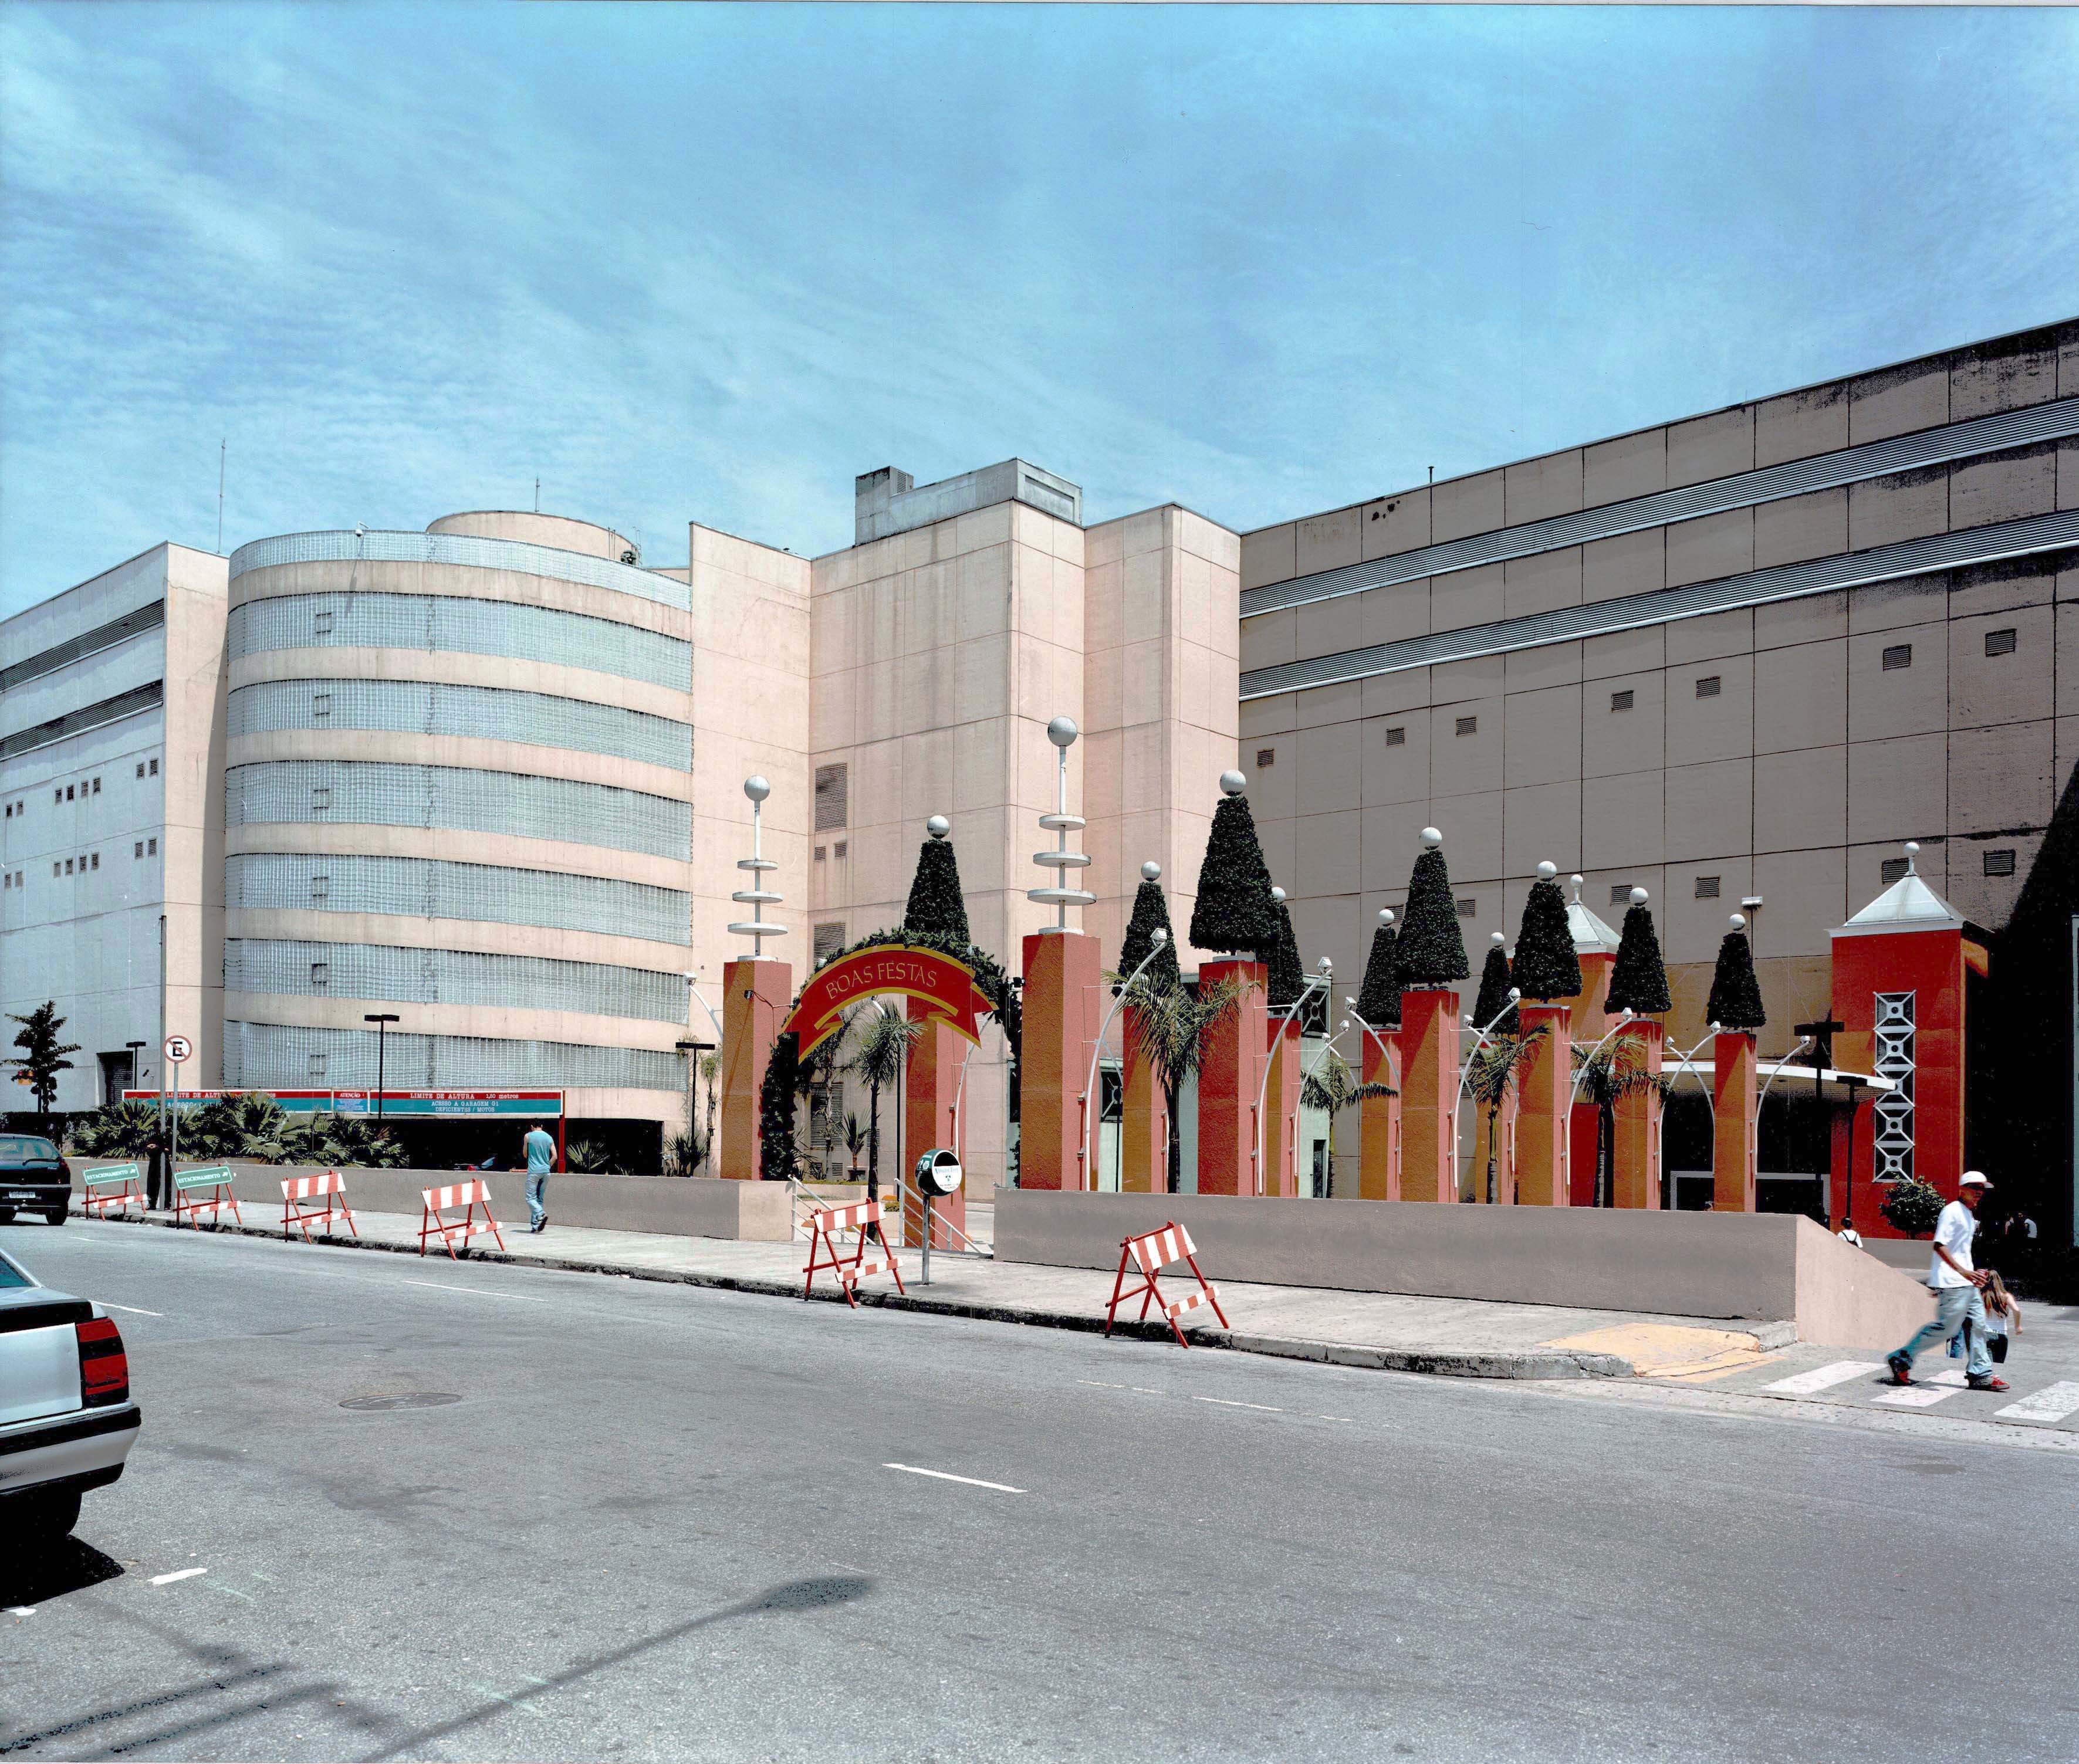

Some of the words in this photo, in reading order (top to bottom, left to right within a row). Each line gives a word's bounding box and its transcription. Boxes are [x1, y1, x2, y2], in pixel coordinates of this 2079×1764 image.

[826, 966, 873, 999] BOAS
[878, 963, 937, 987] FESTAS
[173, 1041, 182, 1057] E
[86, 1170, 129, 1180] ESTACIONAMENTO
[178, 1173, 221, 1183] ESTACIONAMENTO
